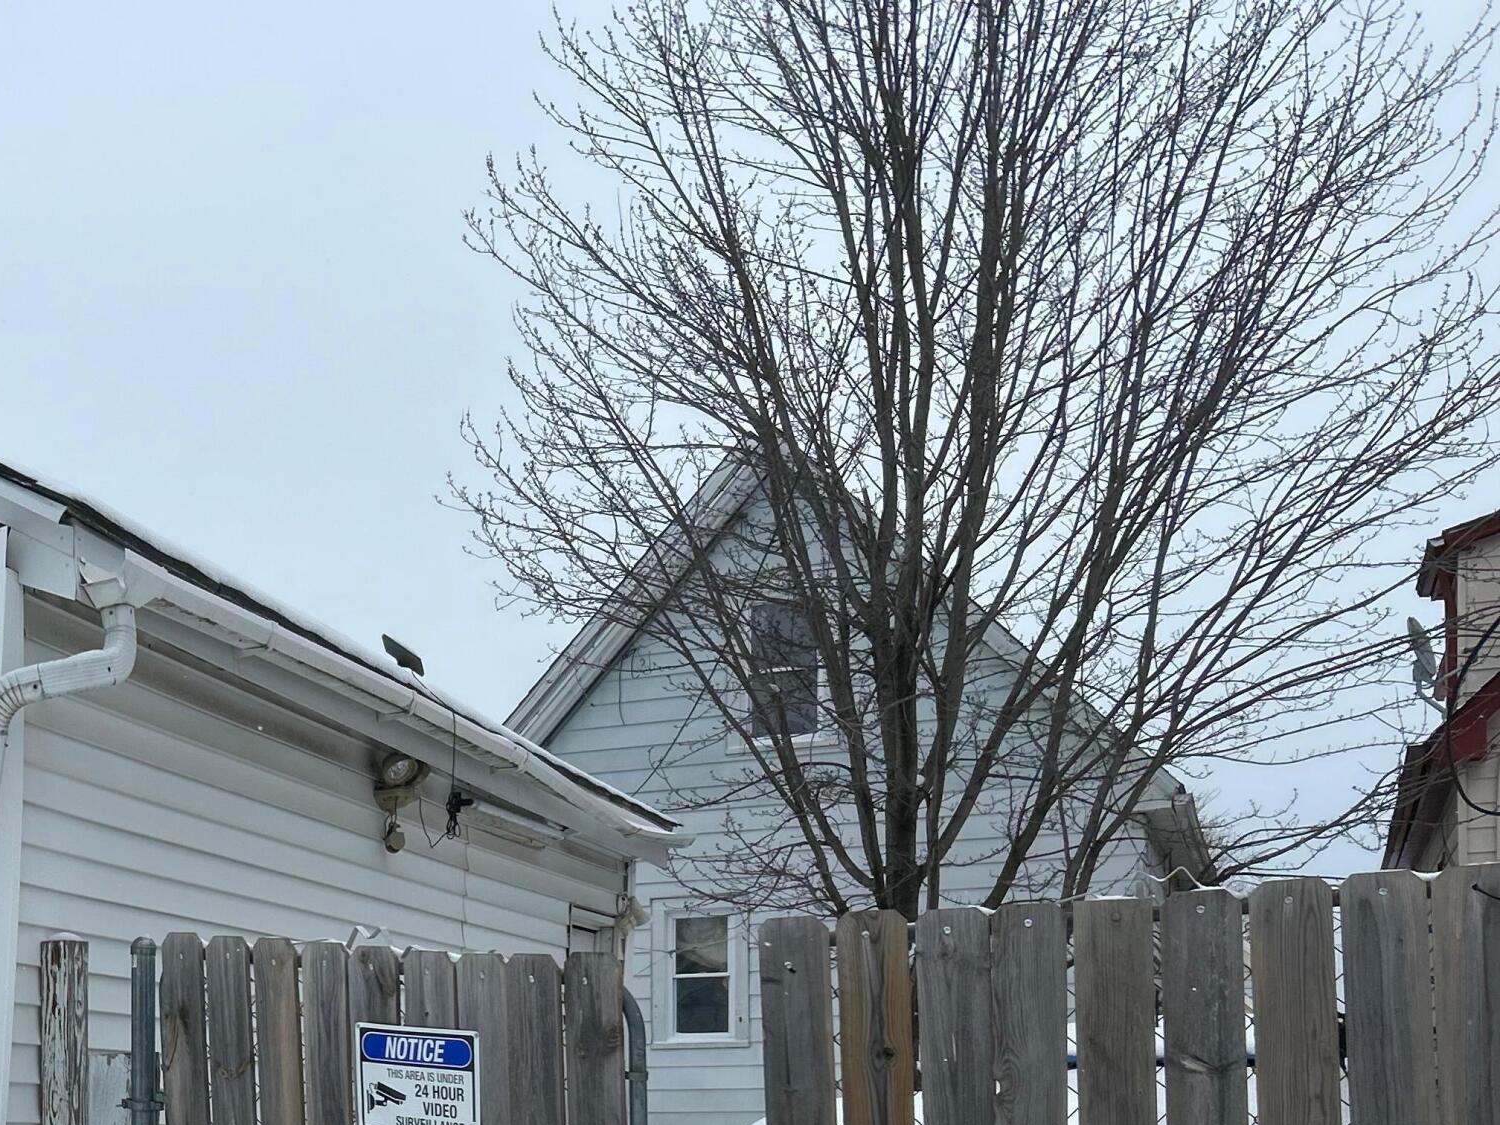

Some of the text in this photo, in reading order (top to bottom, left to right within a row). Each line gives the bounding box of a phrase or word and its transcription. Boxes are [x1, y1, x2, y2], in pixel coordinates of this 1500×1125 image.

[385, 1036, 445, 1063] NOTICE
[387, 1068, 464, 1084] THIS AREA IS UNDER
[414, 1083, 465, 1102] 24 HOUR
[423, 1101, 458, 1119] VIDEO
